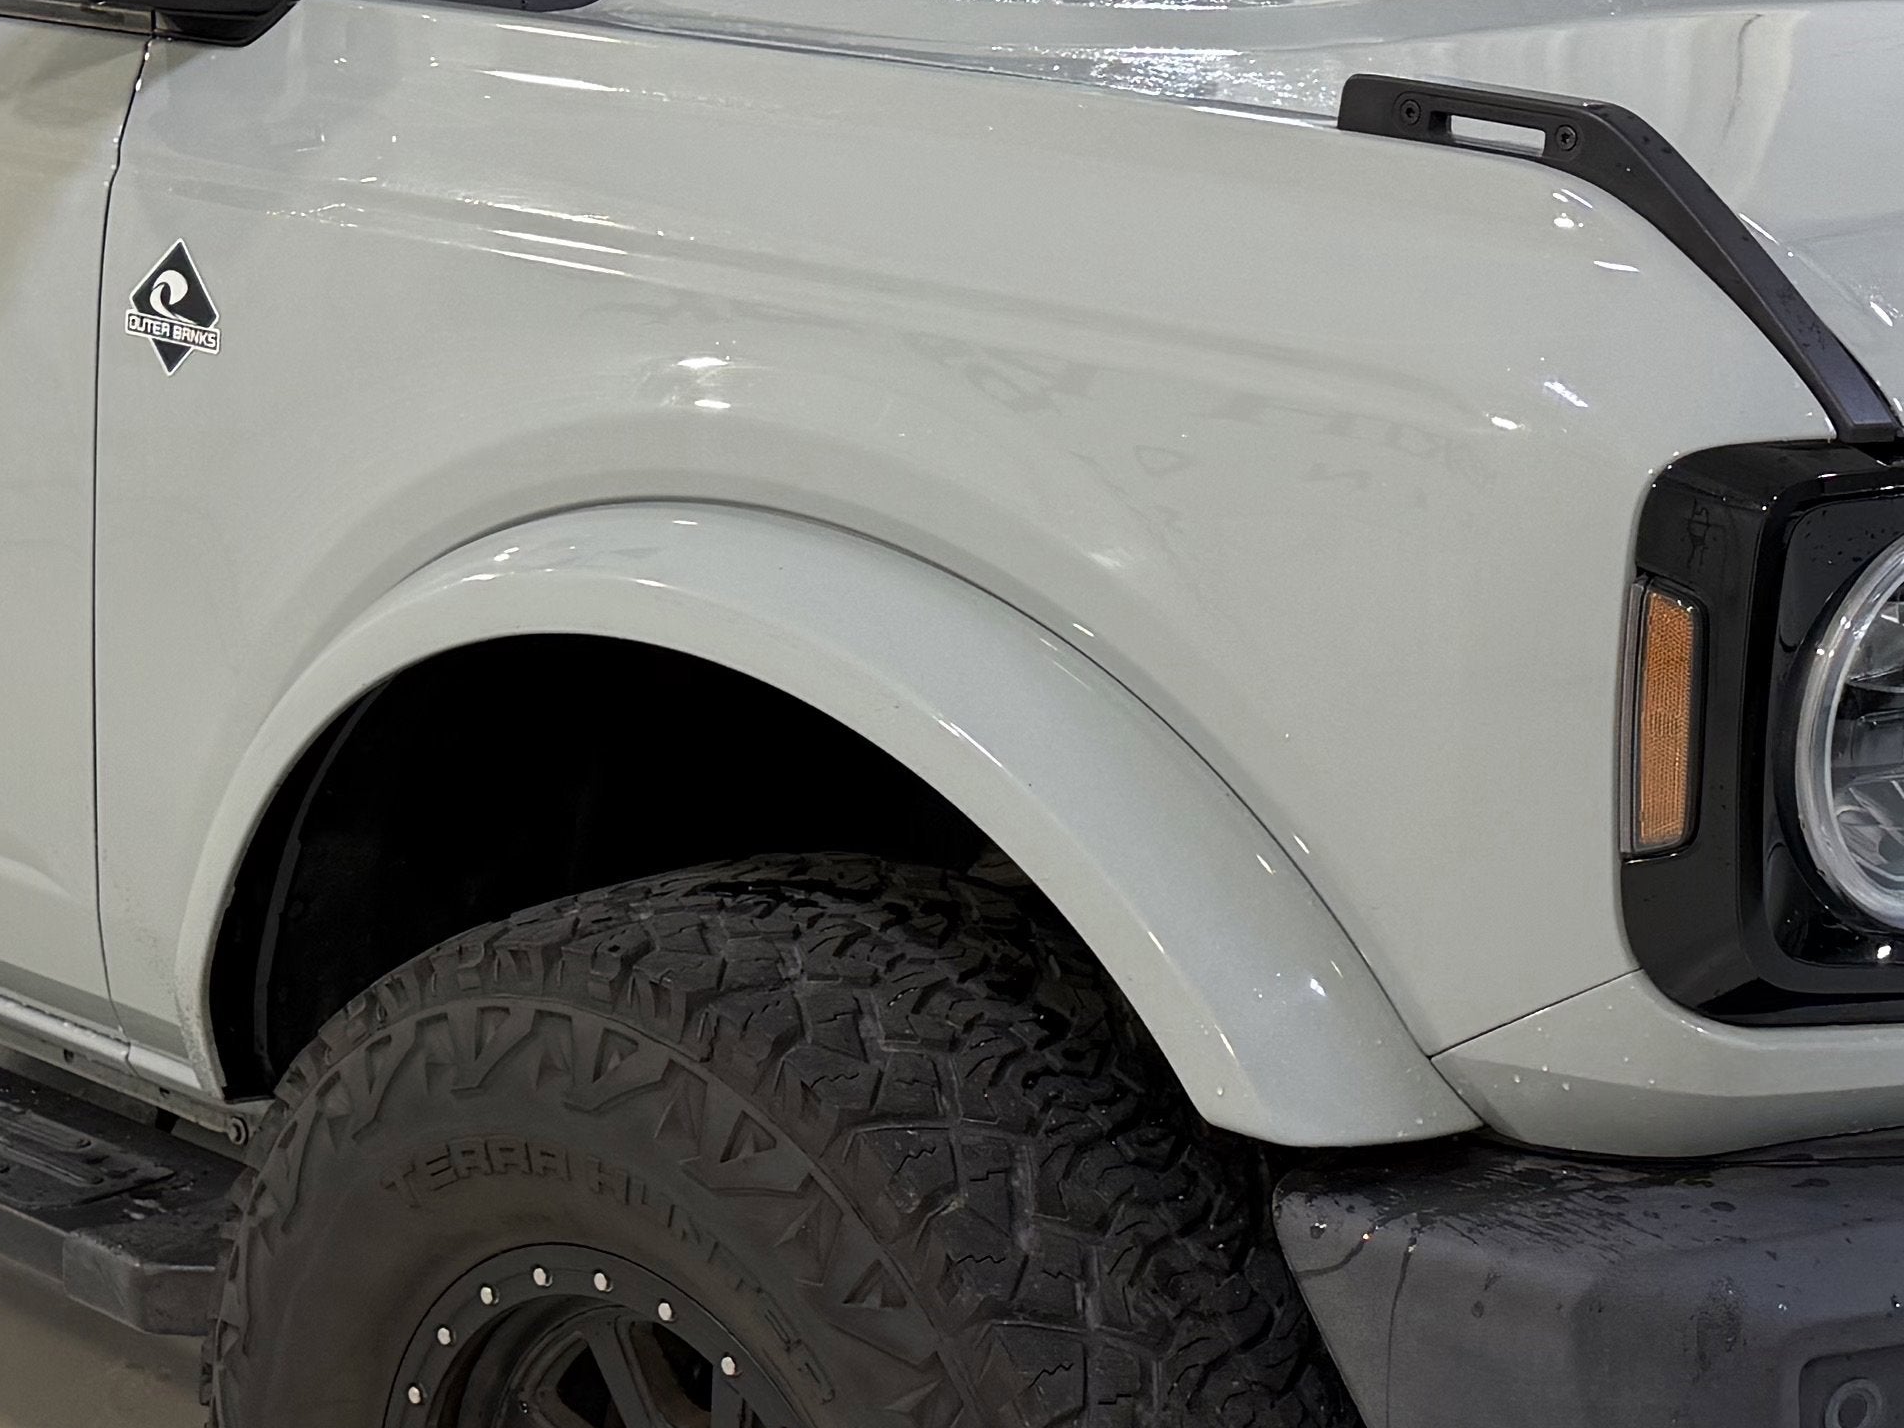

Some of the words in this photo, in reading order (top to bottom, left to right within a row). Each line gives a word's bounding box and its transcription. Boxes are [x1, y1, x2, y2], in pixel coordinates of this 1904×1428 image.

[129, 315, 171, 337] OUTER
[173, 325, 216, 348] BANKS
[381, 1133, 572, 1208] TERRA
